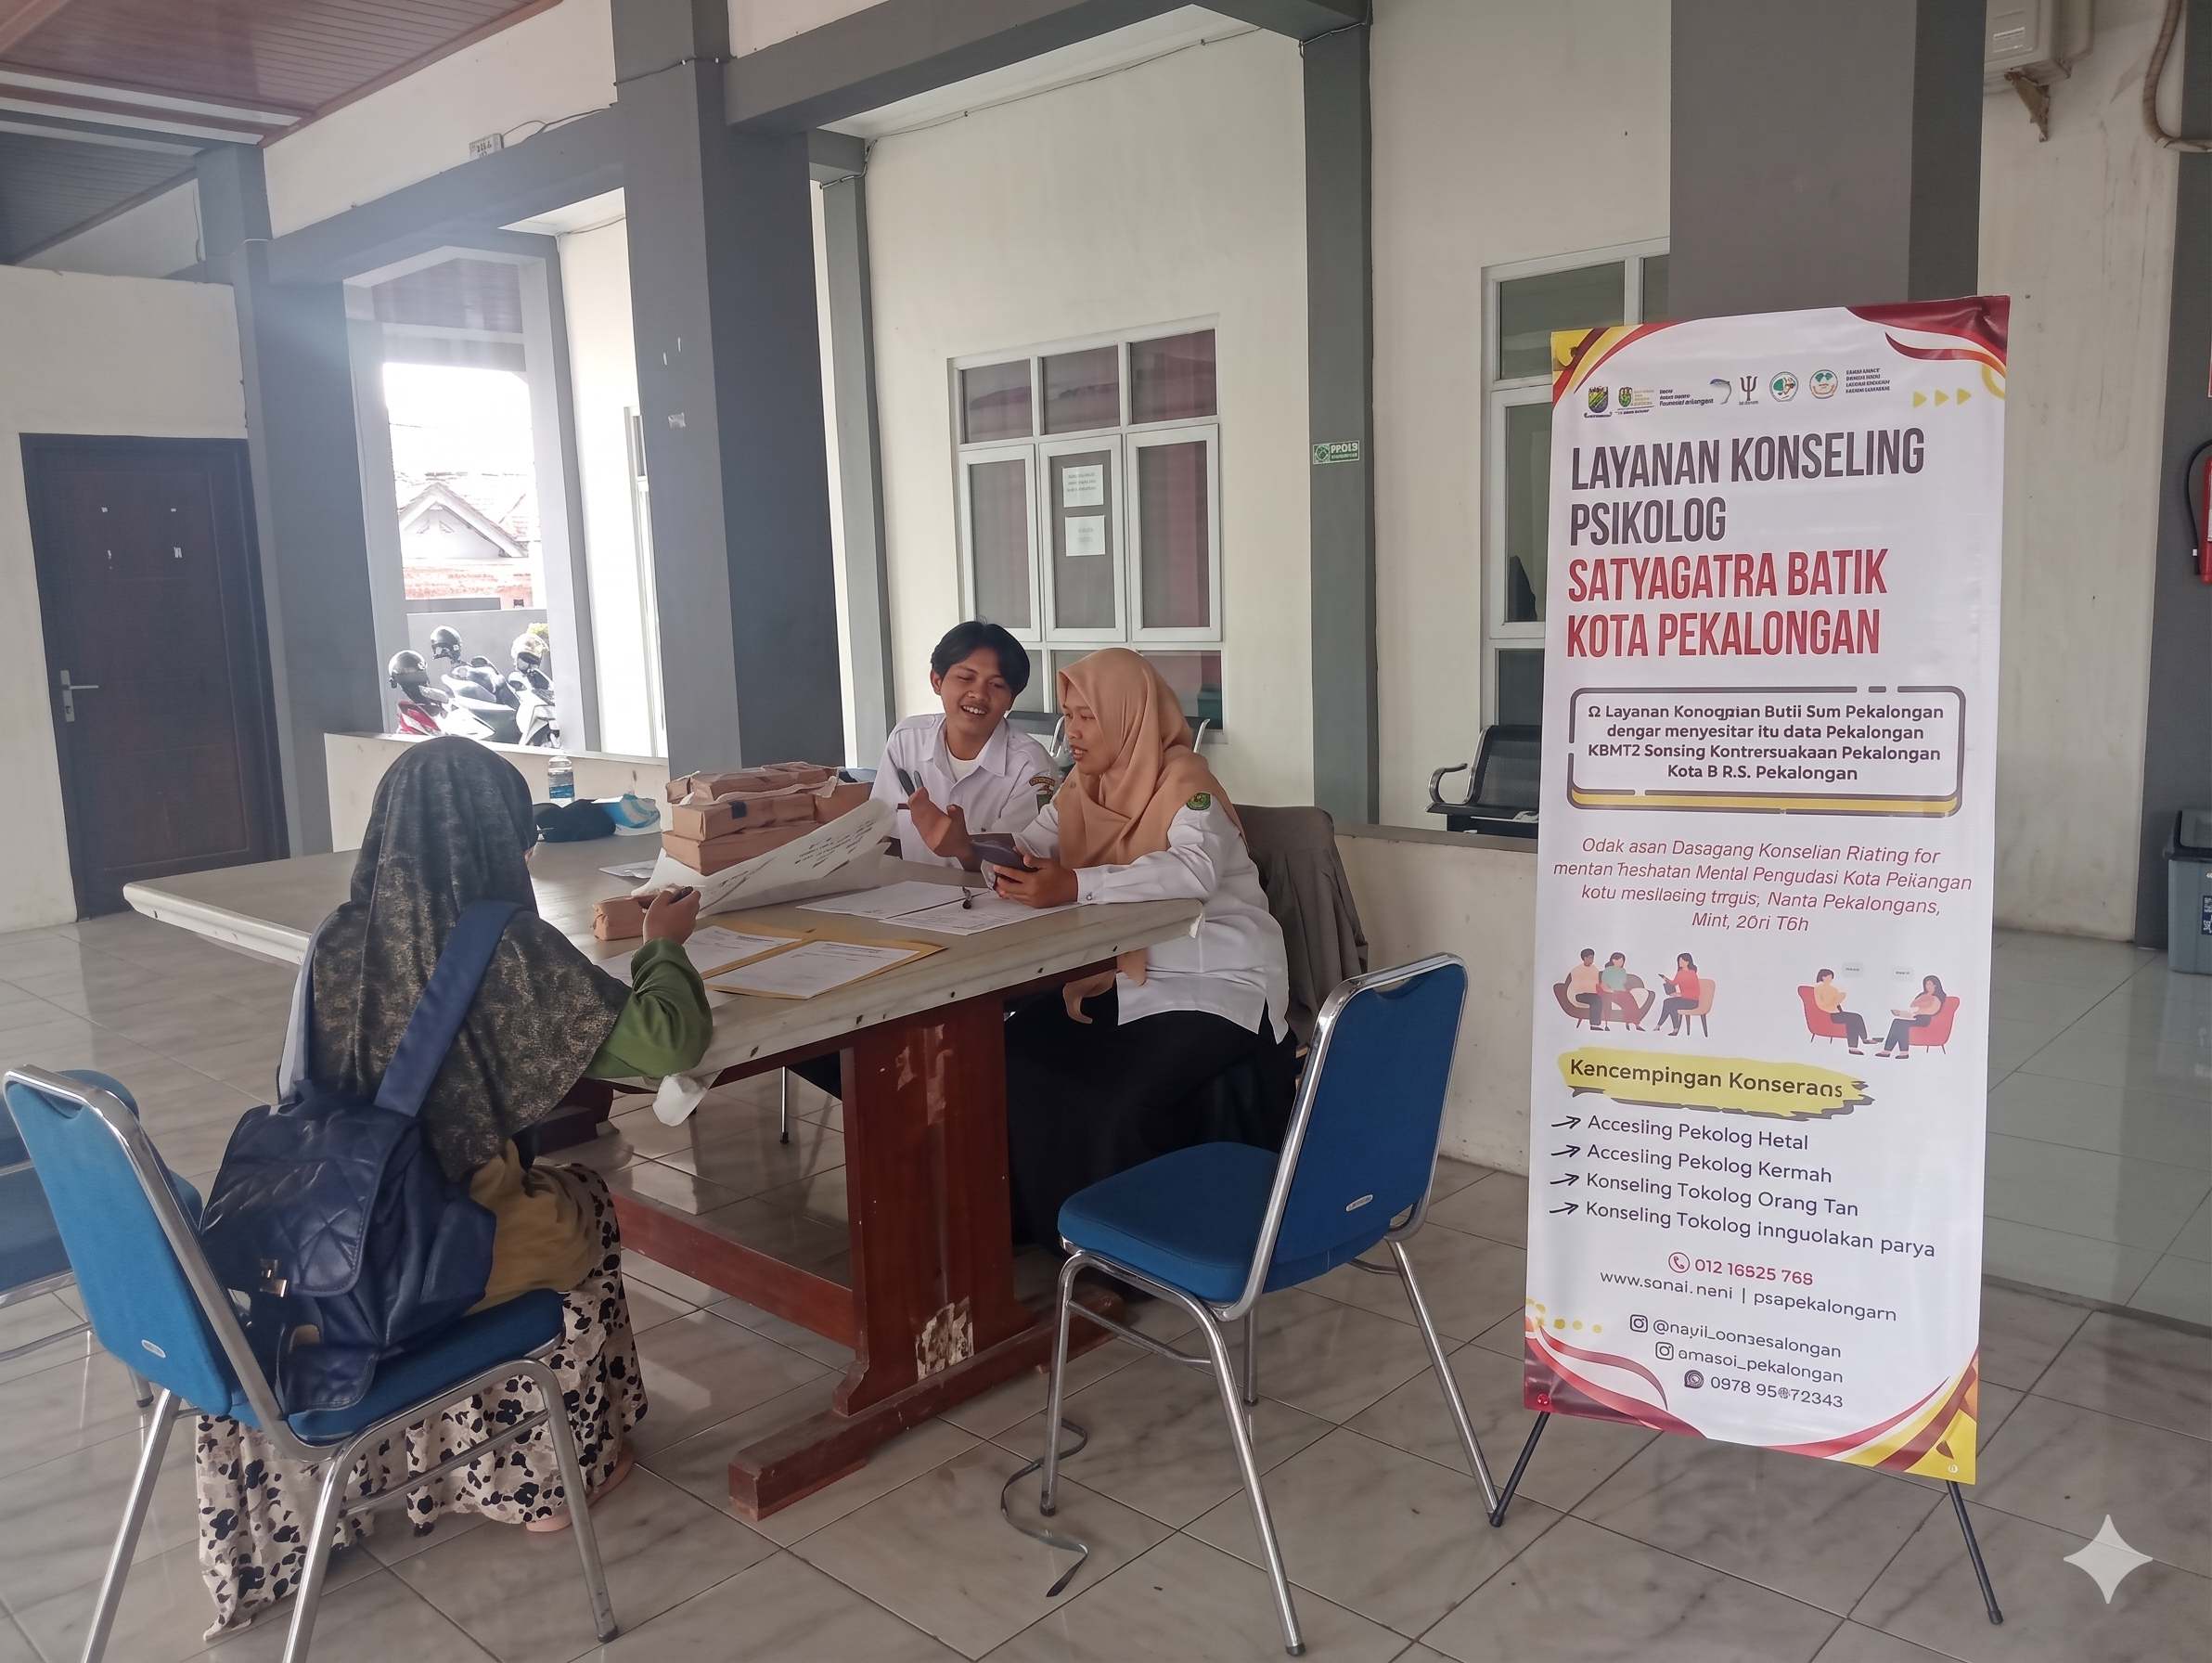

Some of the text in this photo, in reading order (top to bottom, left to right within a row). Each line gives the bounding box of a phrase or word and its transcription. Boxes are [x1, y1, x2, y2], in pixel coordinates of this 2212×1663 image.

[1571, 427, 1924, 491] LAYANAN KONSELING
[1570, 496, 1727, 547] PSIKOLOG
[1568, 548, 1889, 602] SATYAGATRA BATIK
[1567, 608, 1880, 658] KOTA PEKALONGAN
[1605, 704, 1669, 721] Layanan
[1806, 704, 1841, 718] Sum
[1845, 704, 1944, 722] Pekalongan
[1606, 724, 1924, 742] dengar menyesitar itu data Pekalongan
[1588, 743, 1941, 764] KBMT2 Sonsing Kontrersuakaan Pekalongan
[1667, 764, 1858, 783] Kota B R.S. Pekalongan
[1582, 837, 1941, 867] Odak asan Dasagang Konselian Riating for
[1553, 861, 1614, 876] mentan
[1695, 865, 1749, 881] Mental
[1753, 866, 1838, 886] Pengudasi
[1843, 870, 1881, 886] Kota
[1581, 883, 1616, 899] kotu
[1767, 891, 1818, 909] Nanta
[1822, 893, 1940, 917] Pekalongans,
[1691, 912, 1730, 930] Mint,
[1678, 1123, 1752, 1149] Pekolog
[1758, 1130, 1808, 1151] Hetal
[1678, 1153, 1752, 1179] Pekolog
[1758, 1160, 1832, 1183] Kermah
[1587, 1172, 1858, 1217] Konseling Tokolog Orang Tan
[1587, 1201, 1671, 1230] Konseling
[1676, 1211, 1751, 1239] Tokolog
[1881, 1239, 1935, 1258] parya
[1694, 1258, 1723, 1274] 012
[1710, 1376, 1751, 1394] 0978
